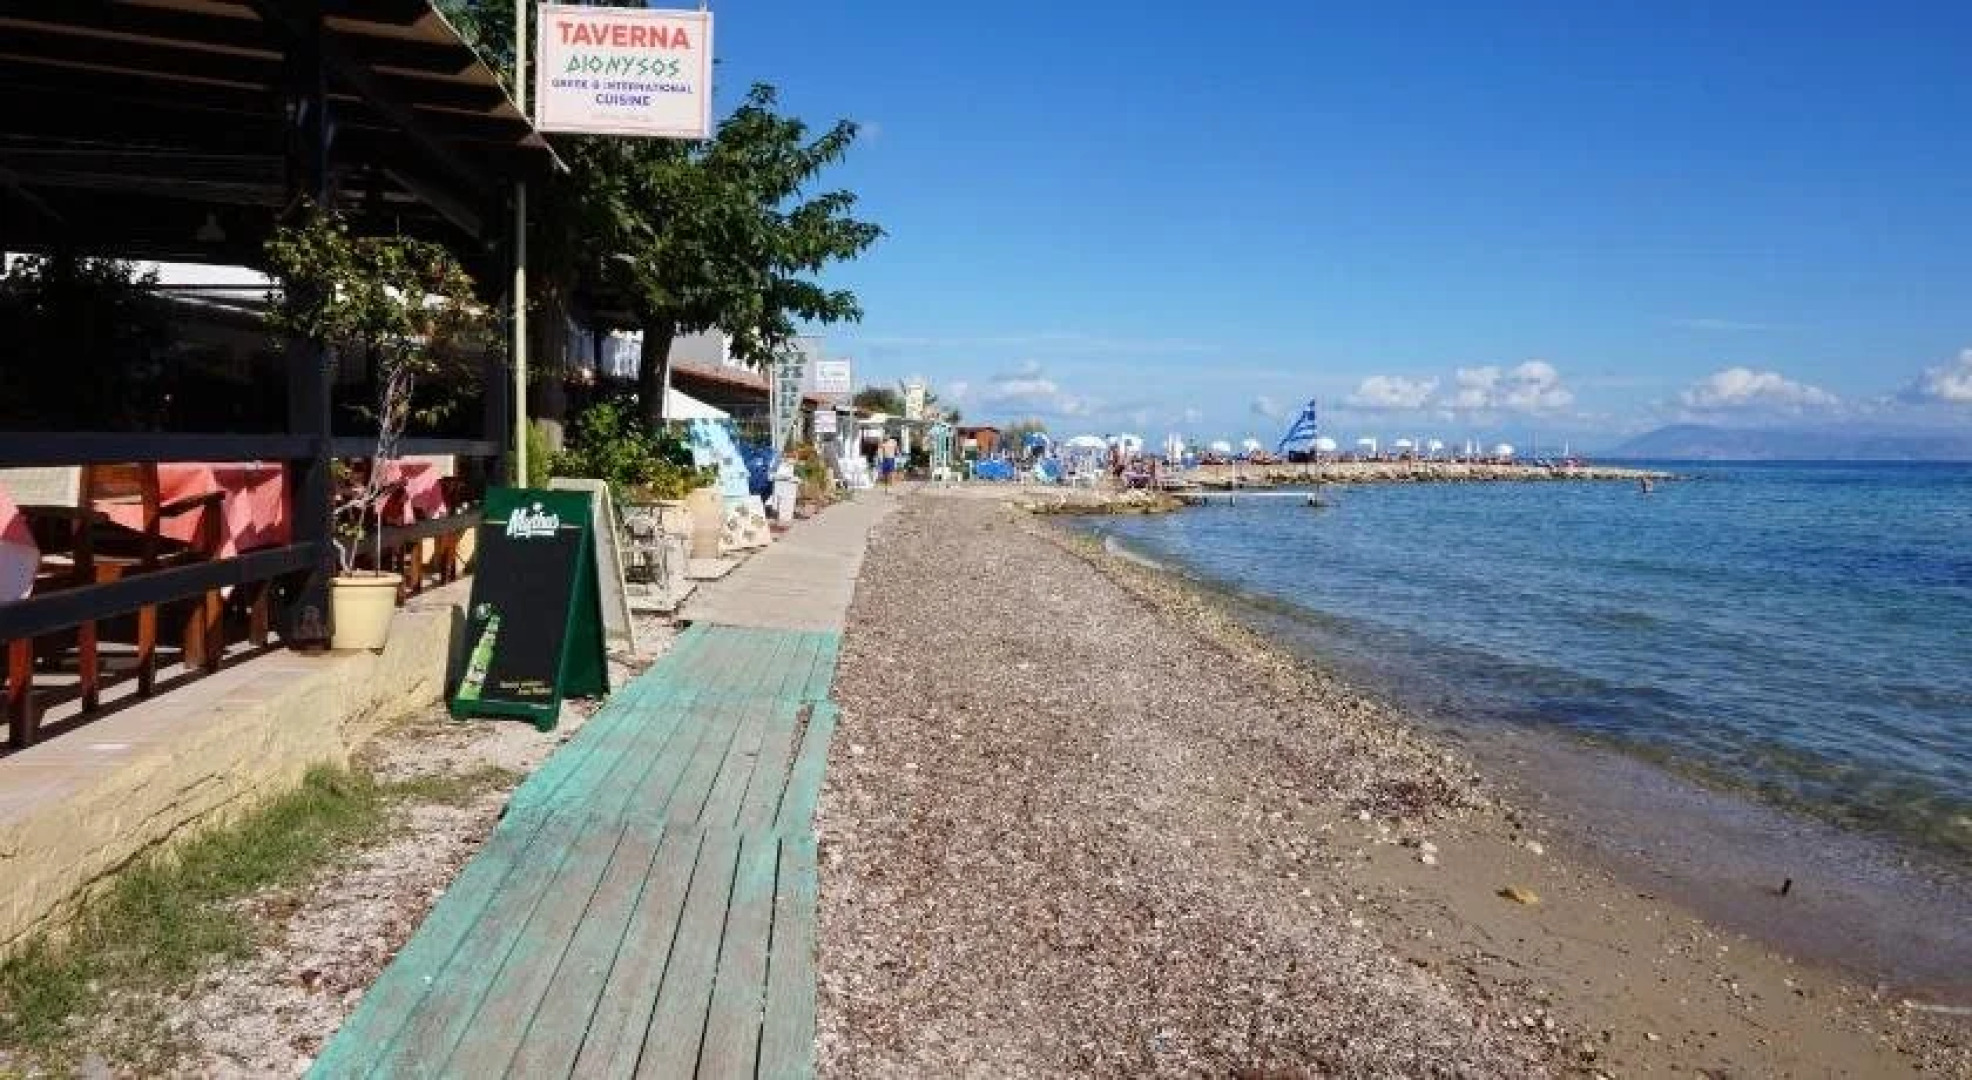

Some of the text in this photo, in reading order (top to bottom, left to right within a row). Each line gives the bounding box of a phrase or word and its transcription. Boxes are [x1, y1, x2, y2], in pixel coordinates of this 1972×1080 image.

[557, 20, 690, 49] TAVERNA
[552, 79, 588, 89] GREEK
[604, 81, 693, 94] INTERNATIONAL
[595, 93, 651, 106] CUISINE
